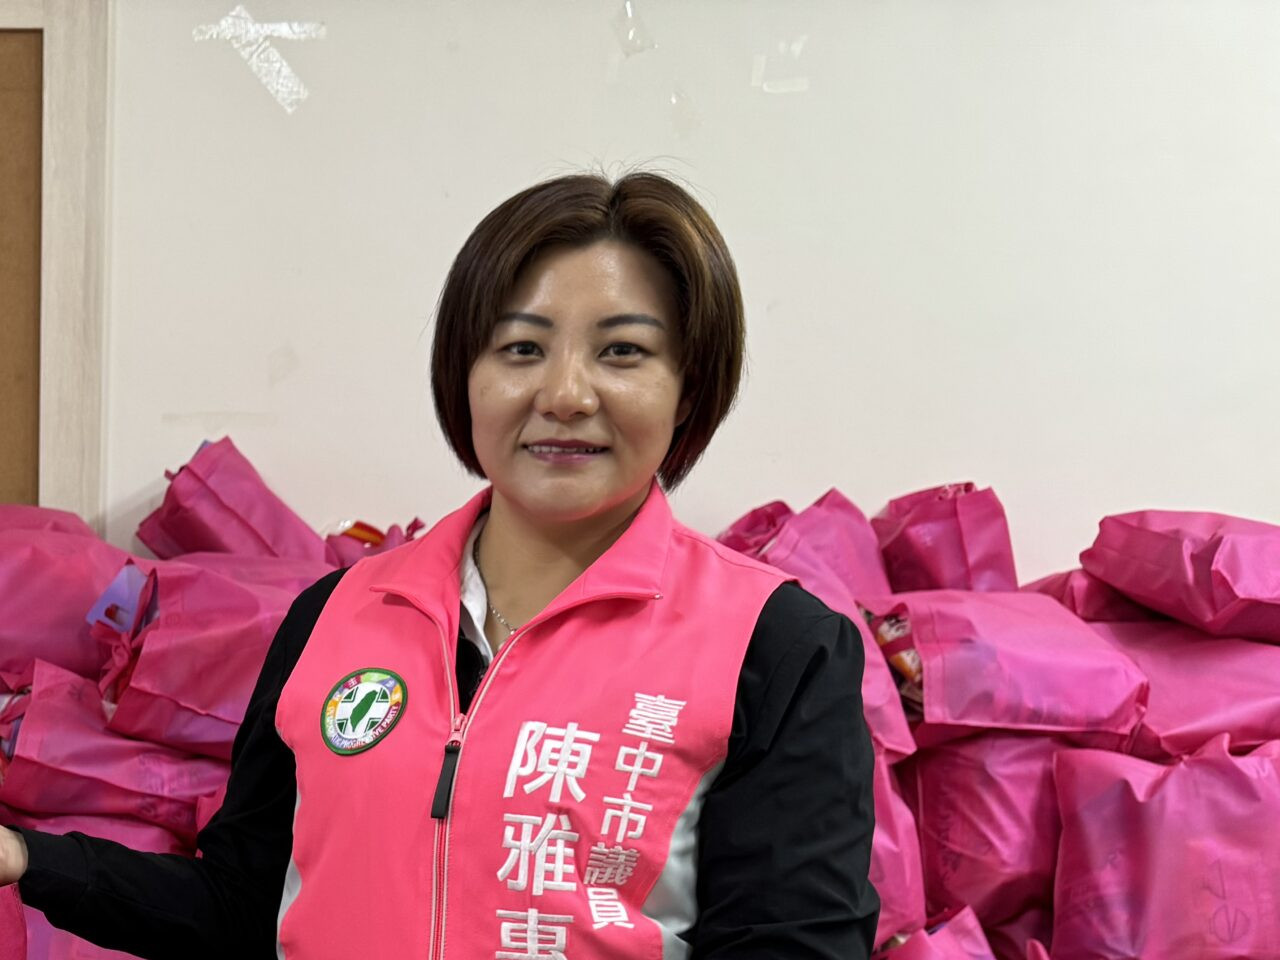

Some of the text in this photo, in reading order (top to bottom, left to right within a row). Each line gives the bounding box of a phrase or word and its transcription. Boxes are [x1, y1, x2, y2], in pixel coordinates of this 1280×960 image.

[584, 692, 686, 929] 臺中市議員
